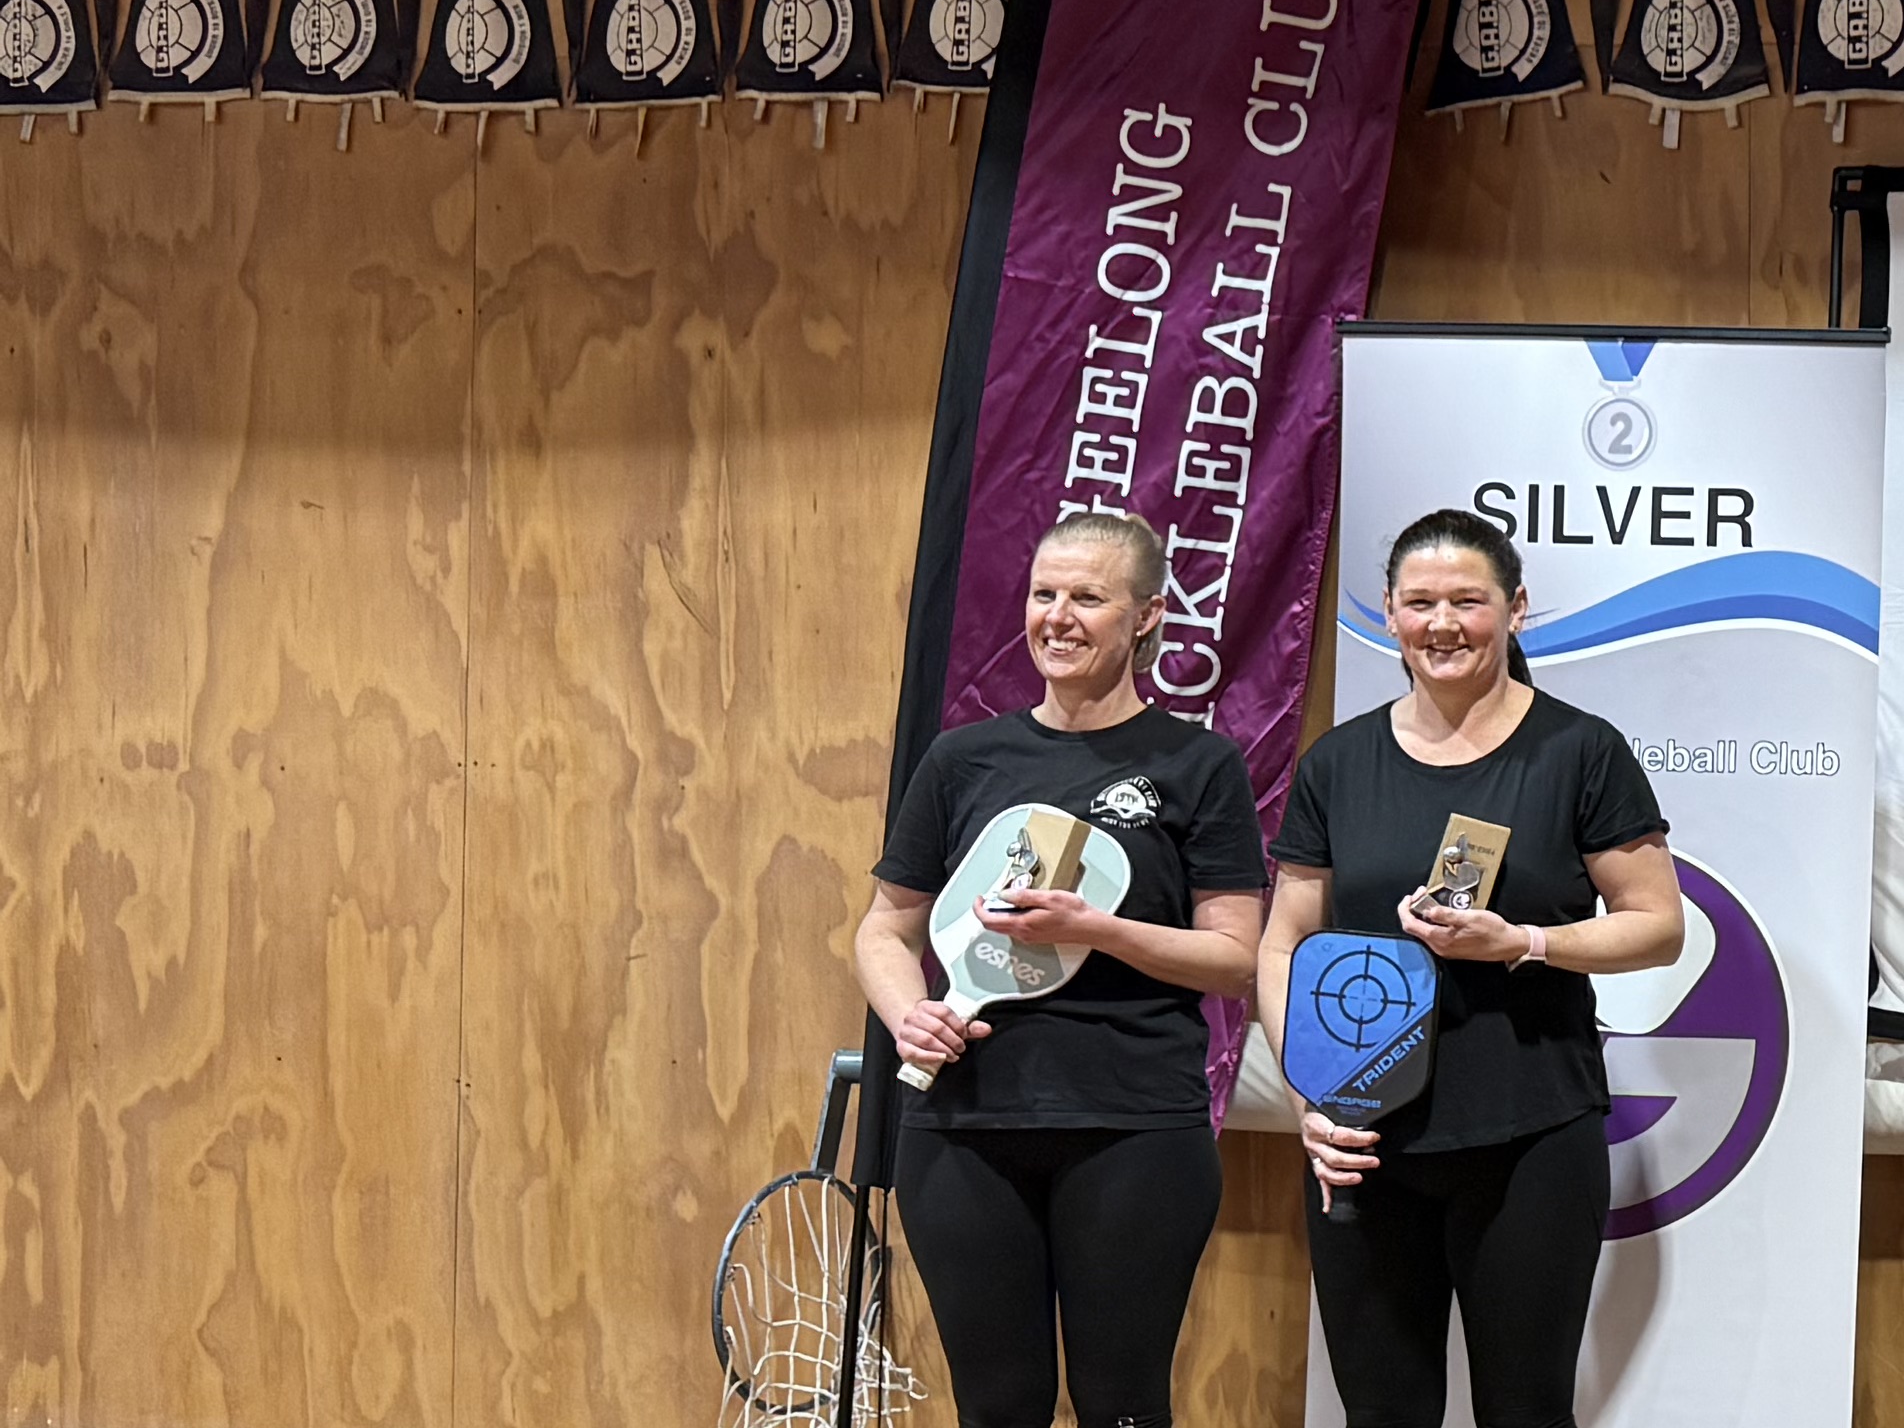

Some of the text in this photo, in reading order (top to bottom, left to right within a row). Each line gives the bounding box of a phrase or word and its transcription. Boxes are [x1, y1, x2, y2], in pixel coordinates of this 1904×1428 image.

[1148, 181, 1293, 730] ICKLEBALL
[1609, 412, 1634, 455] 2
[1473, 481, 1755, 548] SILVER
[1632, 737, 1841, 776] leball Club
[1352, 1026, 1425, 1092] TRIDENT
